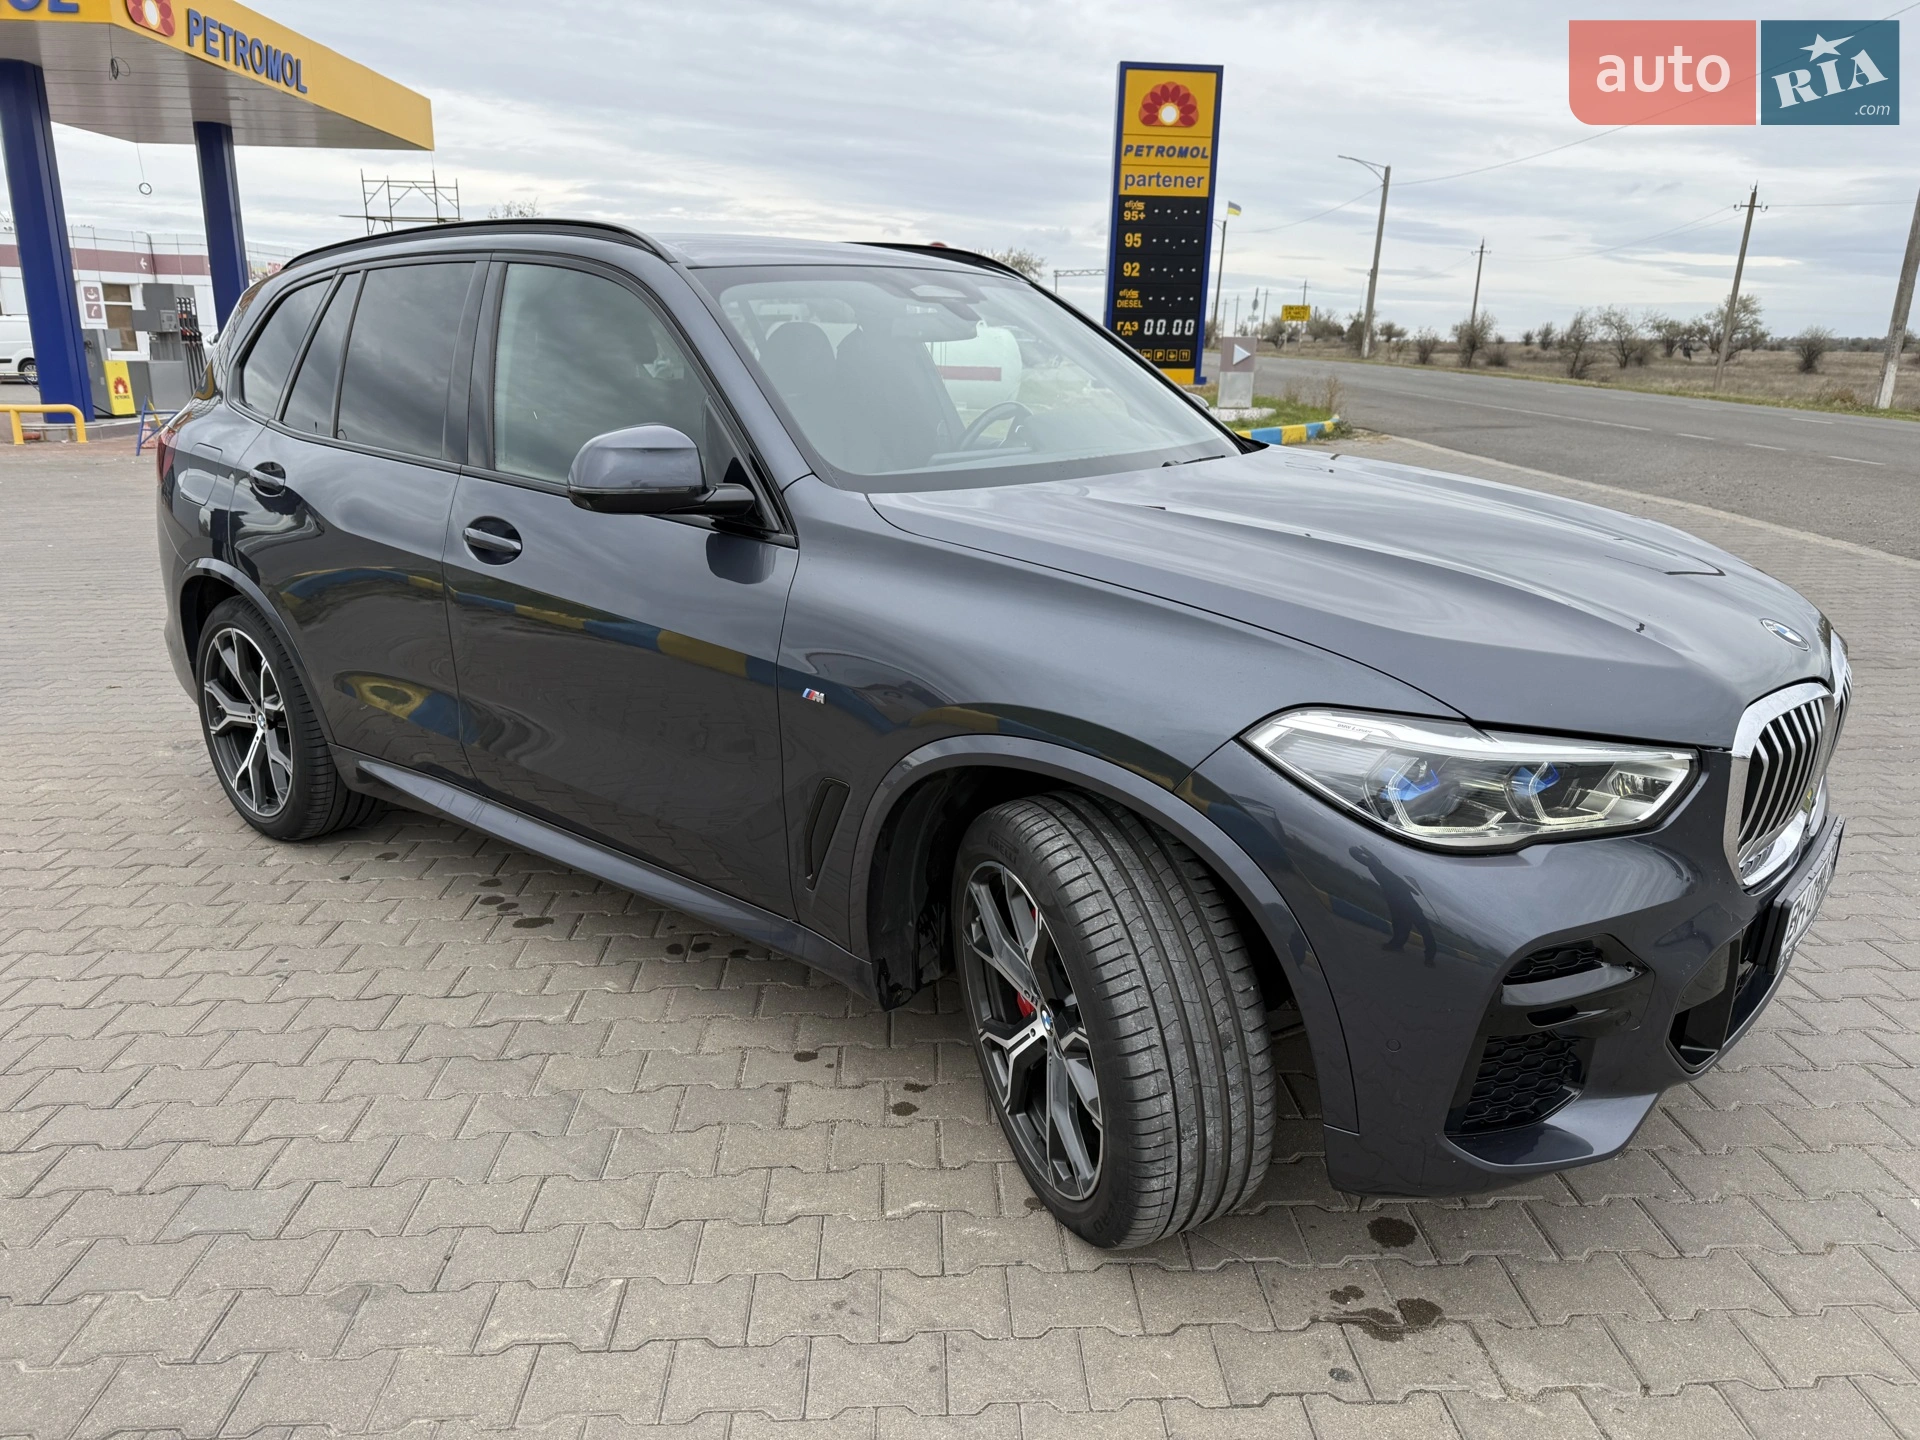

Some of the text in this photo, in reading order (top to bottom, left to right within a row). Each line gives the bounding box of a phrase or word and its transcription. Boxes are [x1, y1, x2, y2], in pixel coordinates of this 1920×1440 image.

[187, 8, 308, 94] PETROMOL
[1123, 144, 1209, 159] PETROMOL
[1124, 171, 1205, 190] partener
[1123, 210, 1146, 221] 95+
[1124, 232, 1142, 248] 95
[1122, 262, 1140, 277] 92
[1116, 299, 1143, 308] DIESEL
[1117, 318, 1195, 336] ГАЗ 00.00
